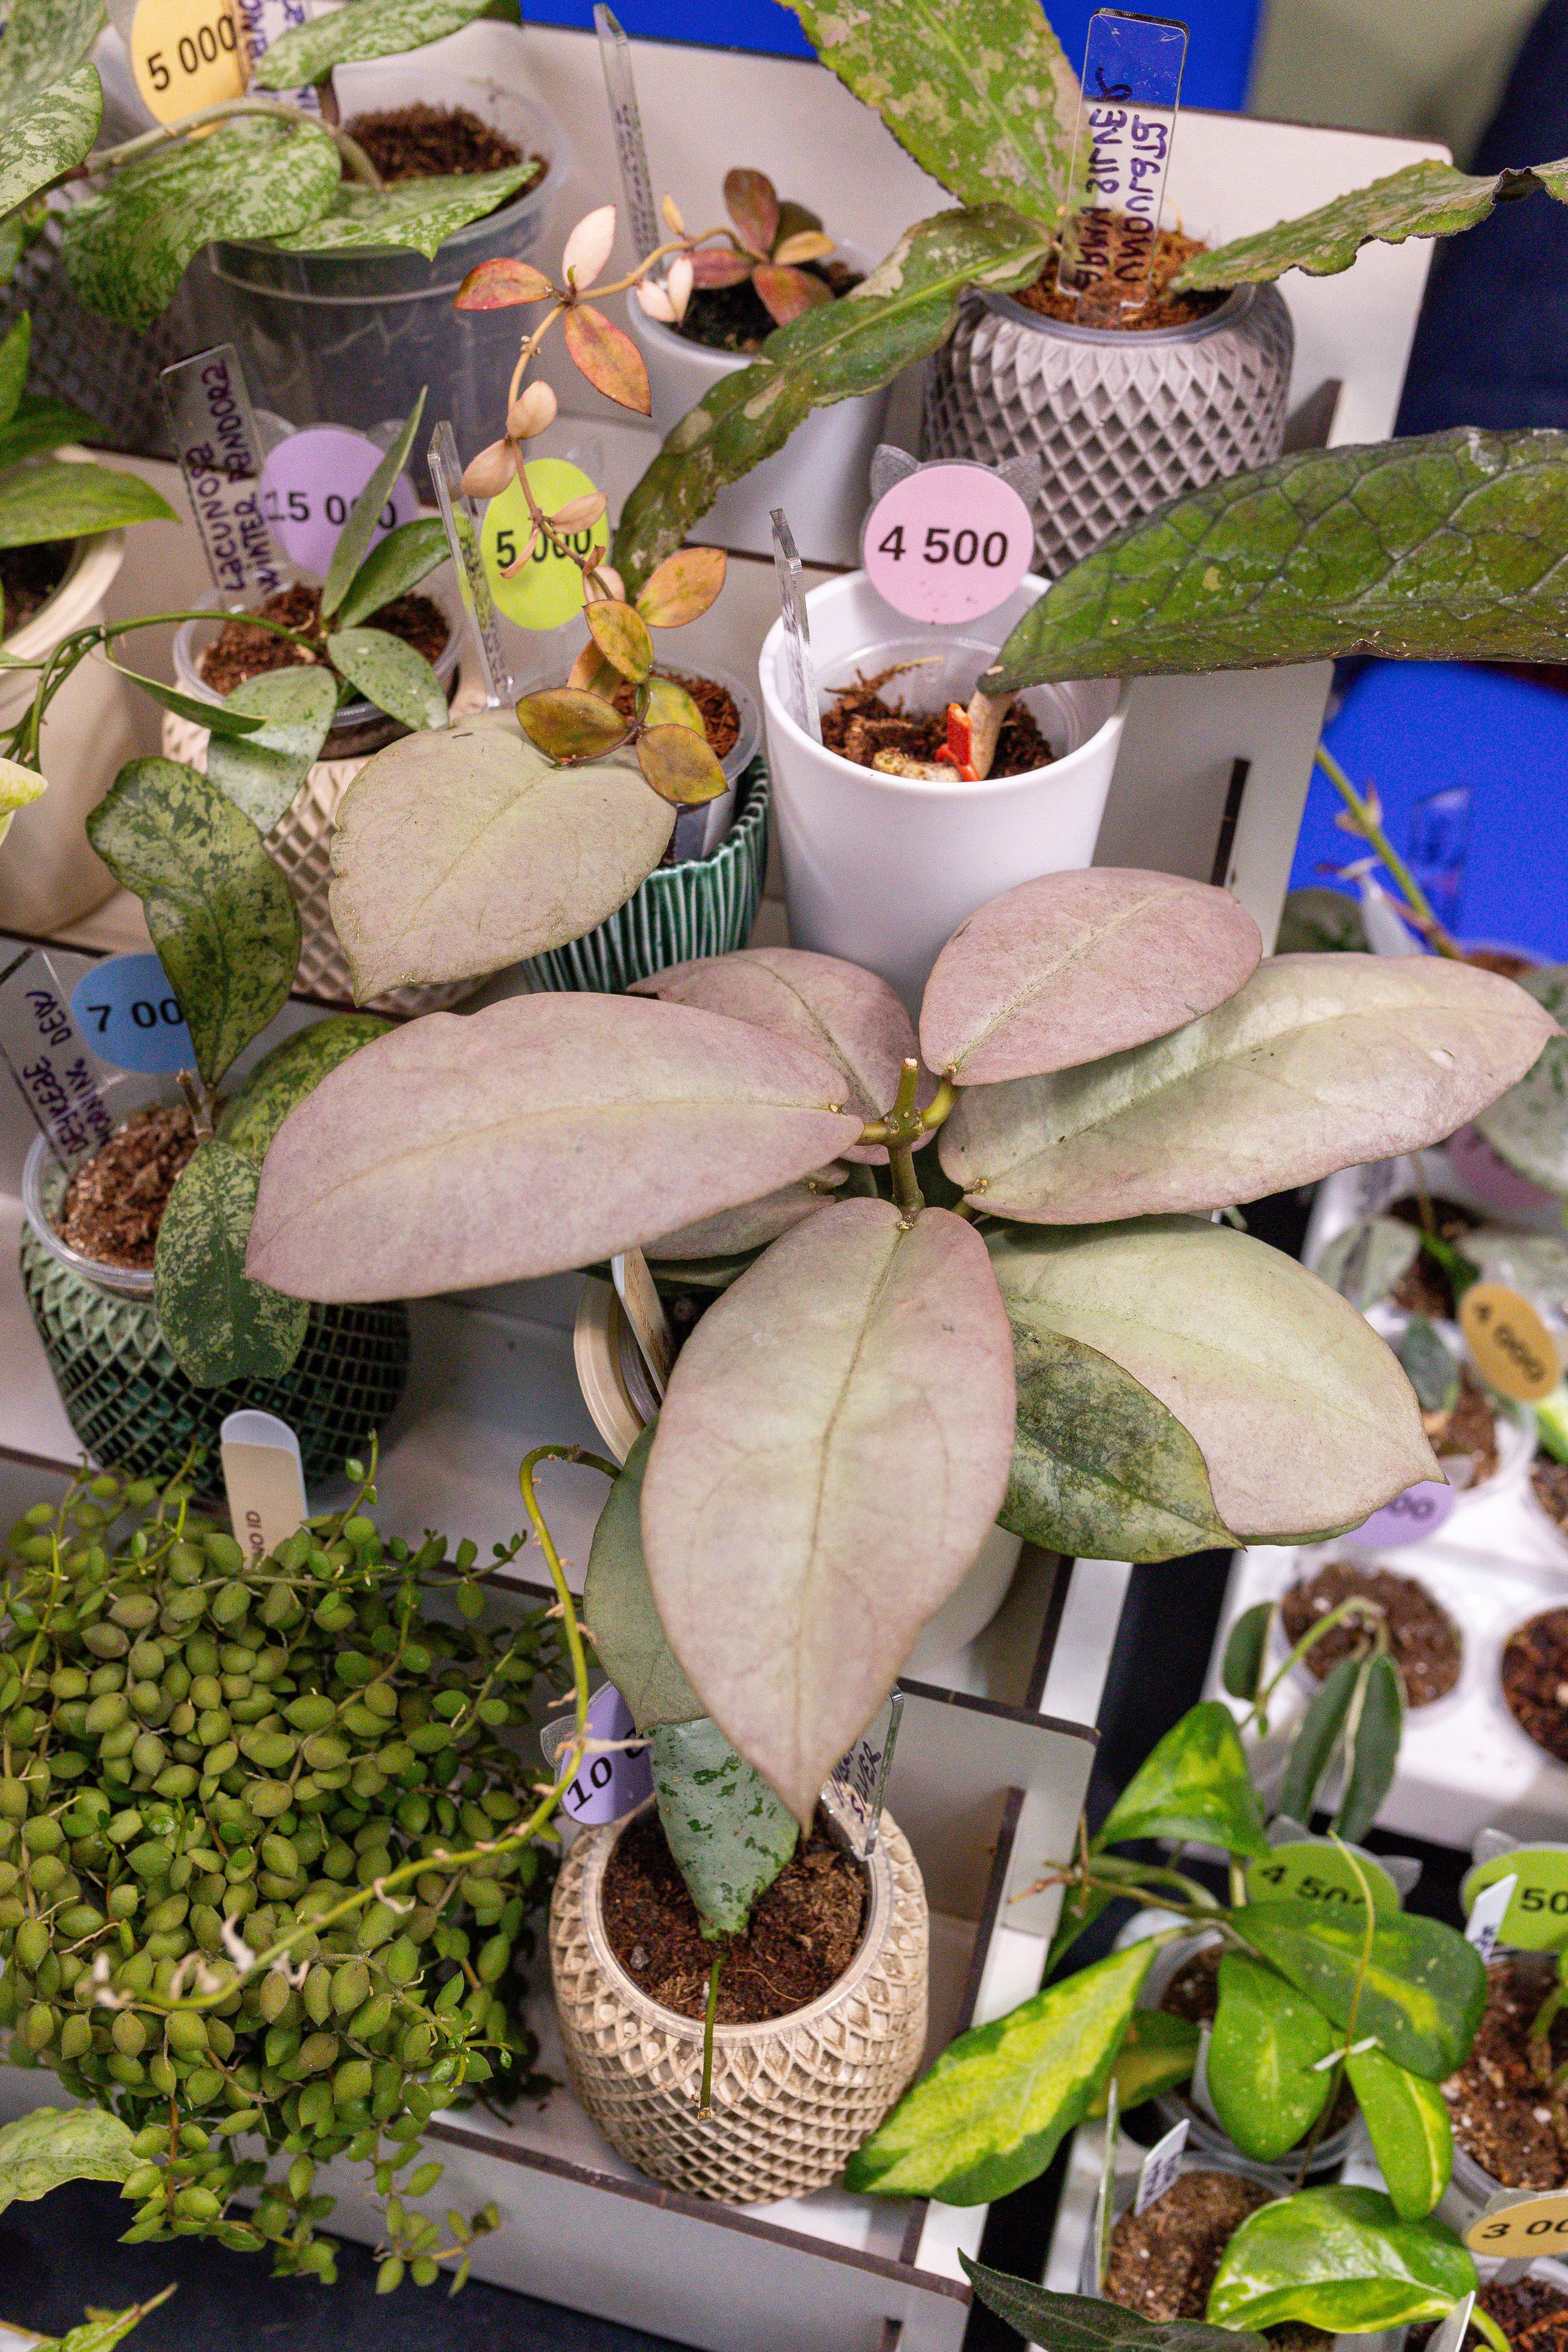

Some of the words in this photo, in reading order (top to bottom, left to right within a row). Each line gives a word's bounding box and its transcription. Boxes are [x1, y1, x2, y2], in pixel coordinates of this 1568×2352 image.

[147, 51, 170, 91] 5
[178, 15, 237, 74] 000
[265, 491, 309, 522] 15
[325, 494, 396, 529] 00
[496, 530, 516, 568] 5
[878, 526, 906, 561] 4
[923, 527, 1008, 567] 500
[87, 1005, 111, 1033] 7
[567, 1757, 612, 1812] 10
[1482, 2223, 1510, 2239] 3
